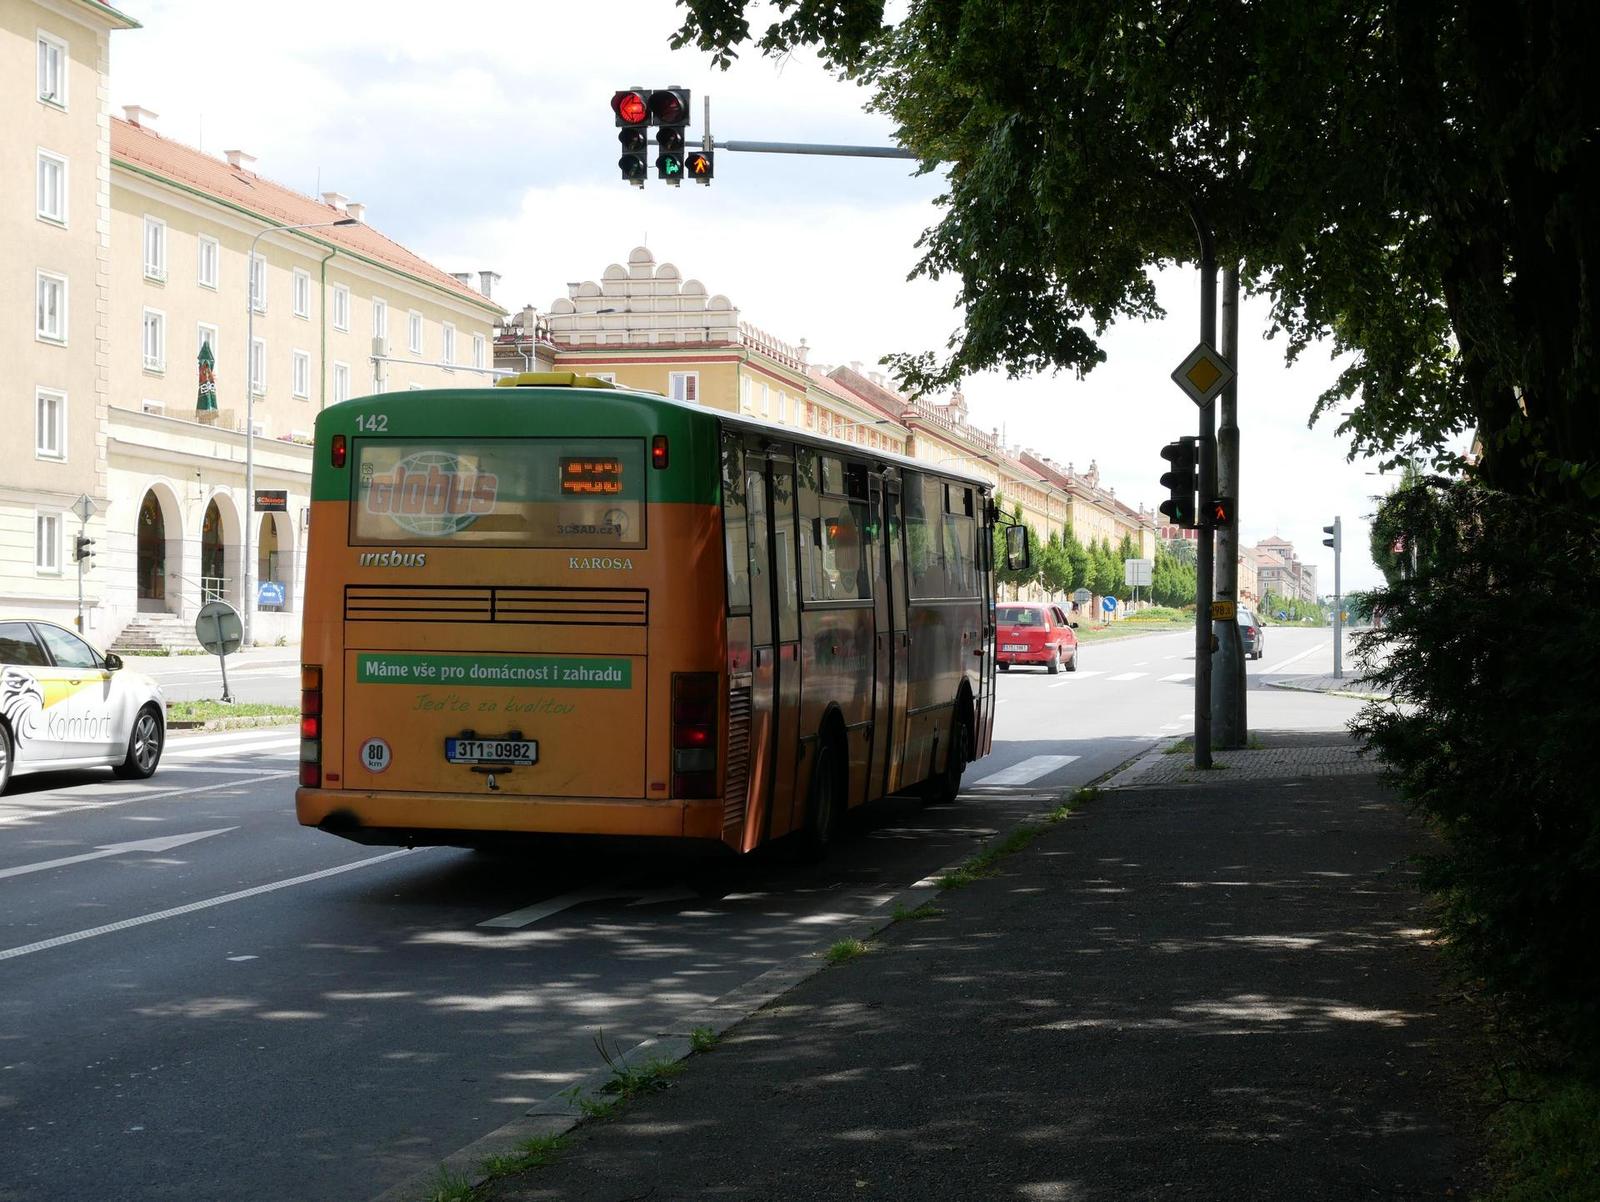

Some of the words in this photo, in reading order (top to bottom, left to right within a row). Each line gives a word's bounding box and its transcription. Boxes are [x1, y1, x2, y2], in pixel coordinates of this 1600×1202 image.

[355, 414, 389, 432] 142
[366, 463, 500, 518] Globus
[568, 557, 633, 570] KAROSA
[365, 661, 409, 677] Máme
[412, 662, 436, 677] vše
[440, 666, 465, 681] pro
[469, 663, 549, 680] domácnost
[553, 665, 559, 680] i
[562, 665, 622, 681] zahradu
[477, 701, 498, 712] za
[504, 695, 576, 714] kvalitou
[47, 710, 111, 741] Komfort
[368, 744, 384, 760] 80
[458, 742, 485, 758] 3T1
[495, 743, 530, 759] 0982
